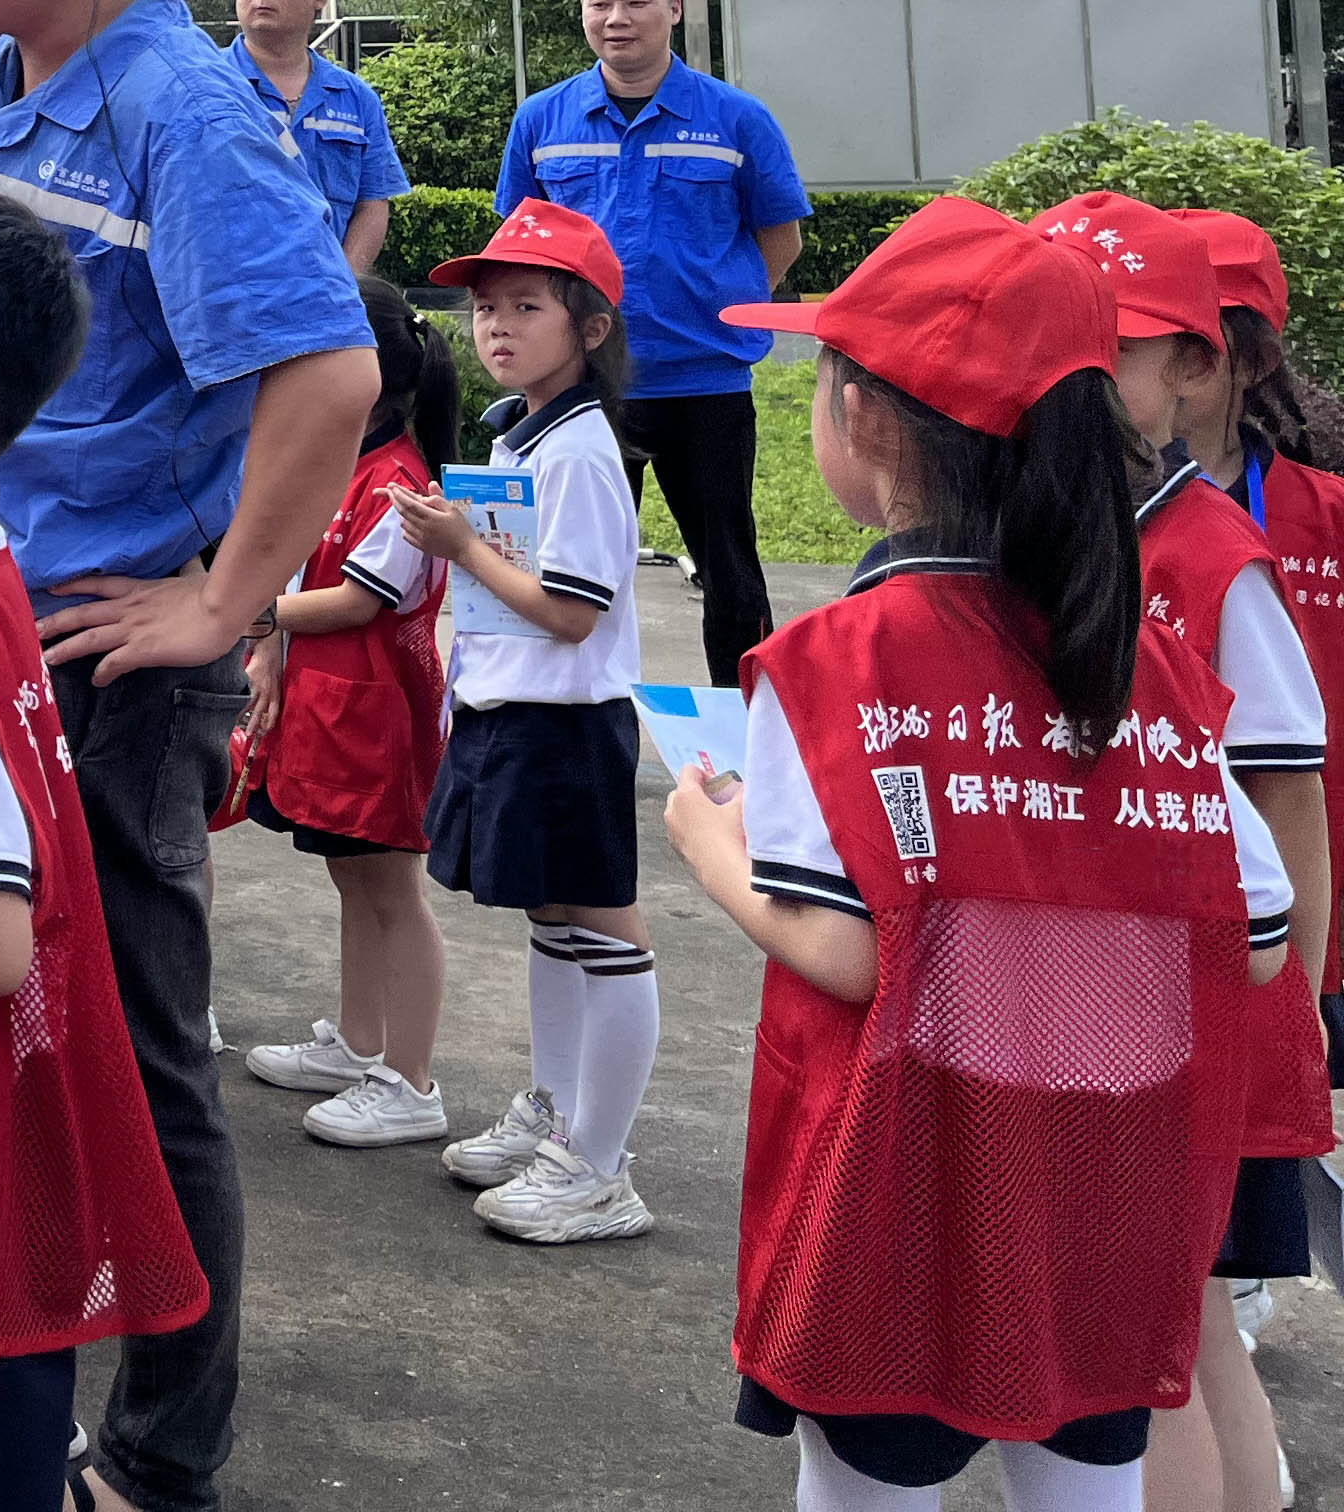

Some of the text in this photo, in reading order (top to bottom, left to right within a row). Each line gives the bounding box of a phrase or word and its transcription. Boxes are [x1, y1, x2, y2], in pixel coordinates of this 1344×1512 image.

[944, 772, 1231, 835] 保护湘江 从我做
